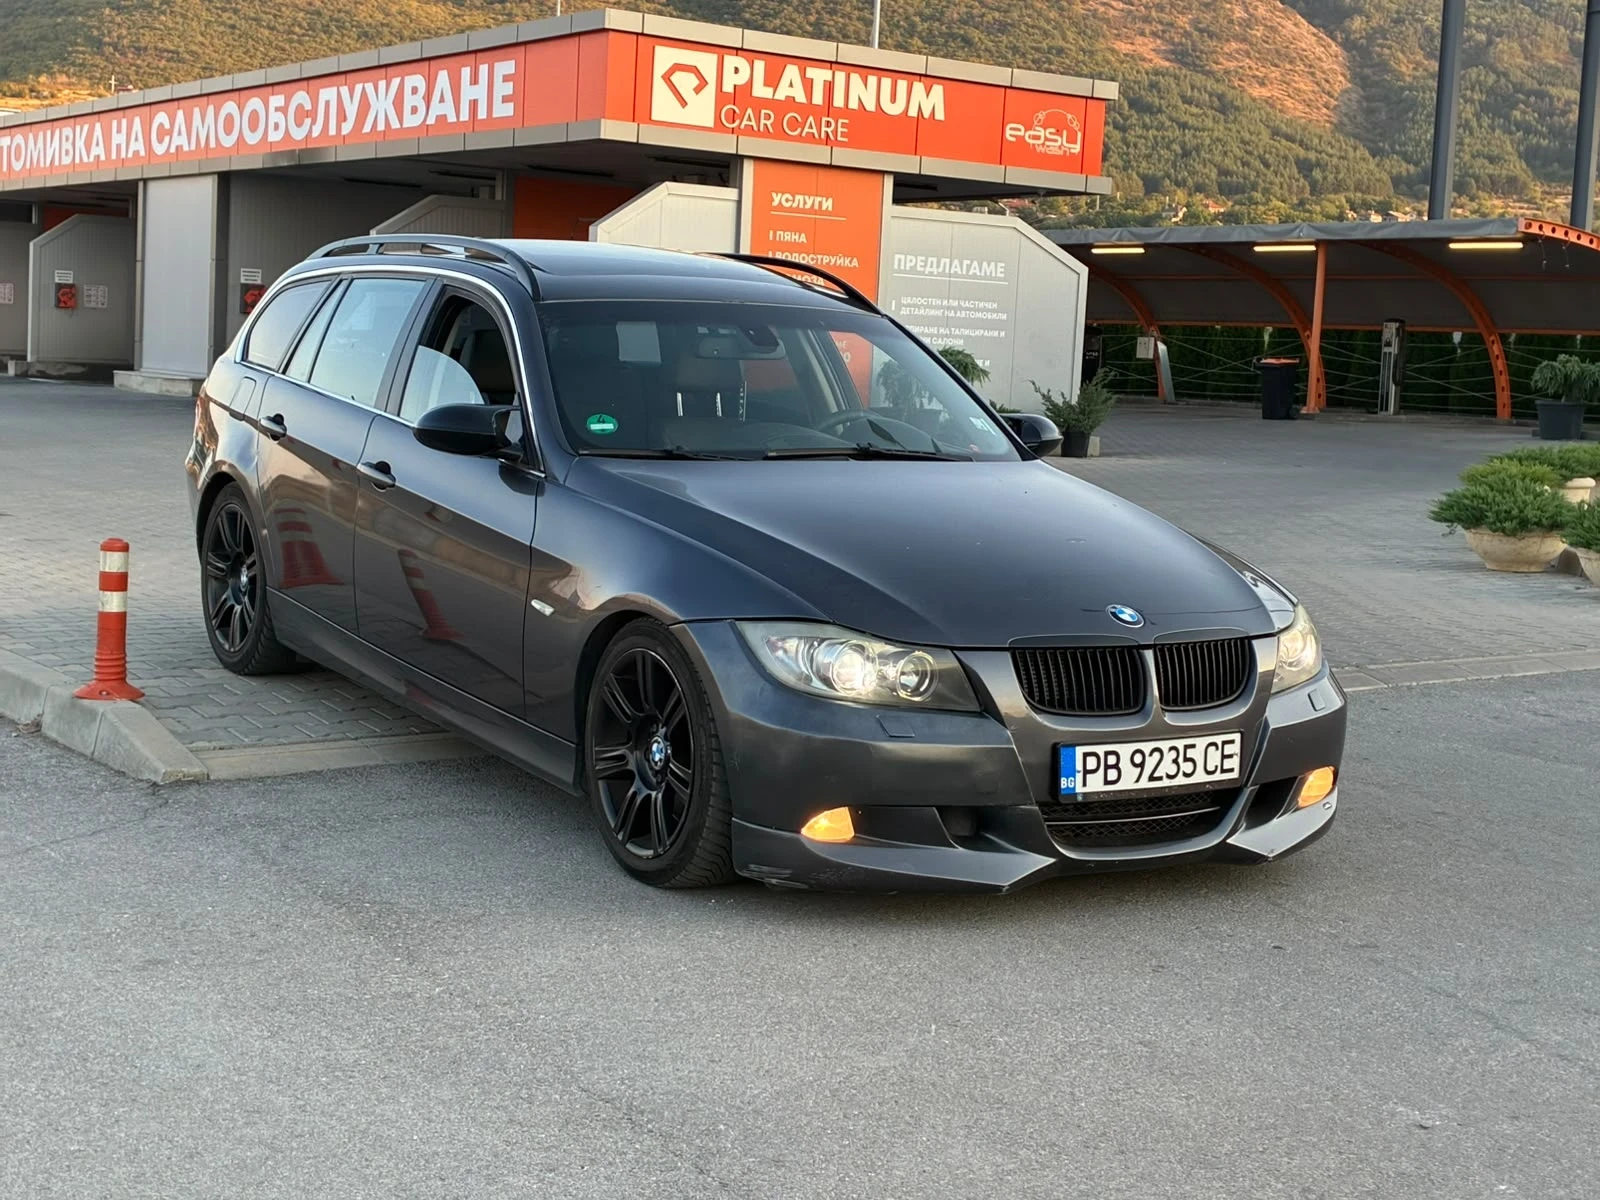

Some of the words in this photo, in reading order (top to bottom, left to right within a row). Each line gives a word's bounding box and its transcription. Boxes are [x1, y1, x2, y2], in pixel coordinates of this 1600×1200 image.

[721, 54, 945, 121] PLATINUM
[111, 116, 145, 160] НА
[151, 59, 515, 156] САМООБСЛУЖВАНЕ
[720, 104, 775, 134] CAR
[782, 112, 849, 142] CARE
[1005, 123, 1081, 154] easy
[771, 192, 833, 211] УСЛУГИ
[776, 230, 807, 243] ПЯНА
[893, 253, 1006, 277] ПРЕДЛАГАМЕ
[901, 296, 941, 307] ЦЯЛОСТЕН
[943, 299, 959, 307] ИЛИ
[960, 300, 998, 309] ЧАСТИЧЕН
[900, 306, 944, 317] ДЕТАЙЛИНГ
[956, 310, 1007, 320] АВТОМОБИЛИ
[932, 336, 965, 346] САЛОНИ
[939, 327, 950, 335] НА
[950, 327, 999, 338] ТАПИЦИРАНИ
[999, 330, 1006, 338] И
[1082, 750, 1122, 788] PB
[1130, 743, 1197, 784] 9235
[1203, 739, 1236, 776] CE
[1060, 777, 1075, 789] BG
